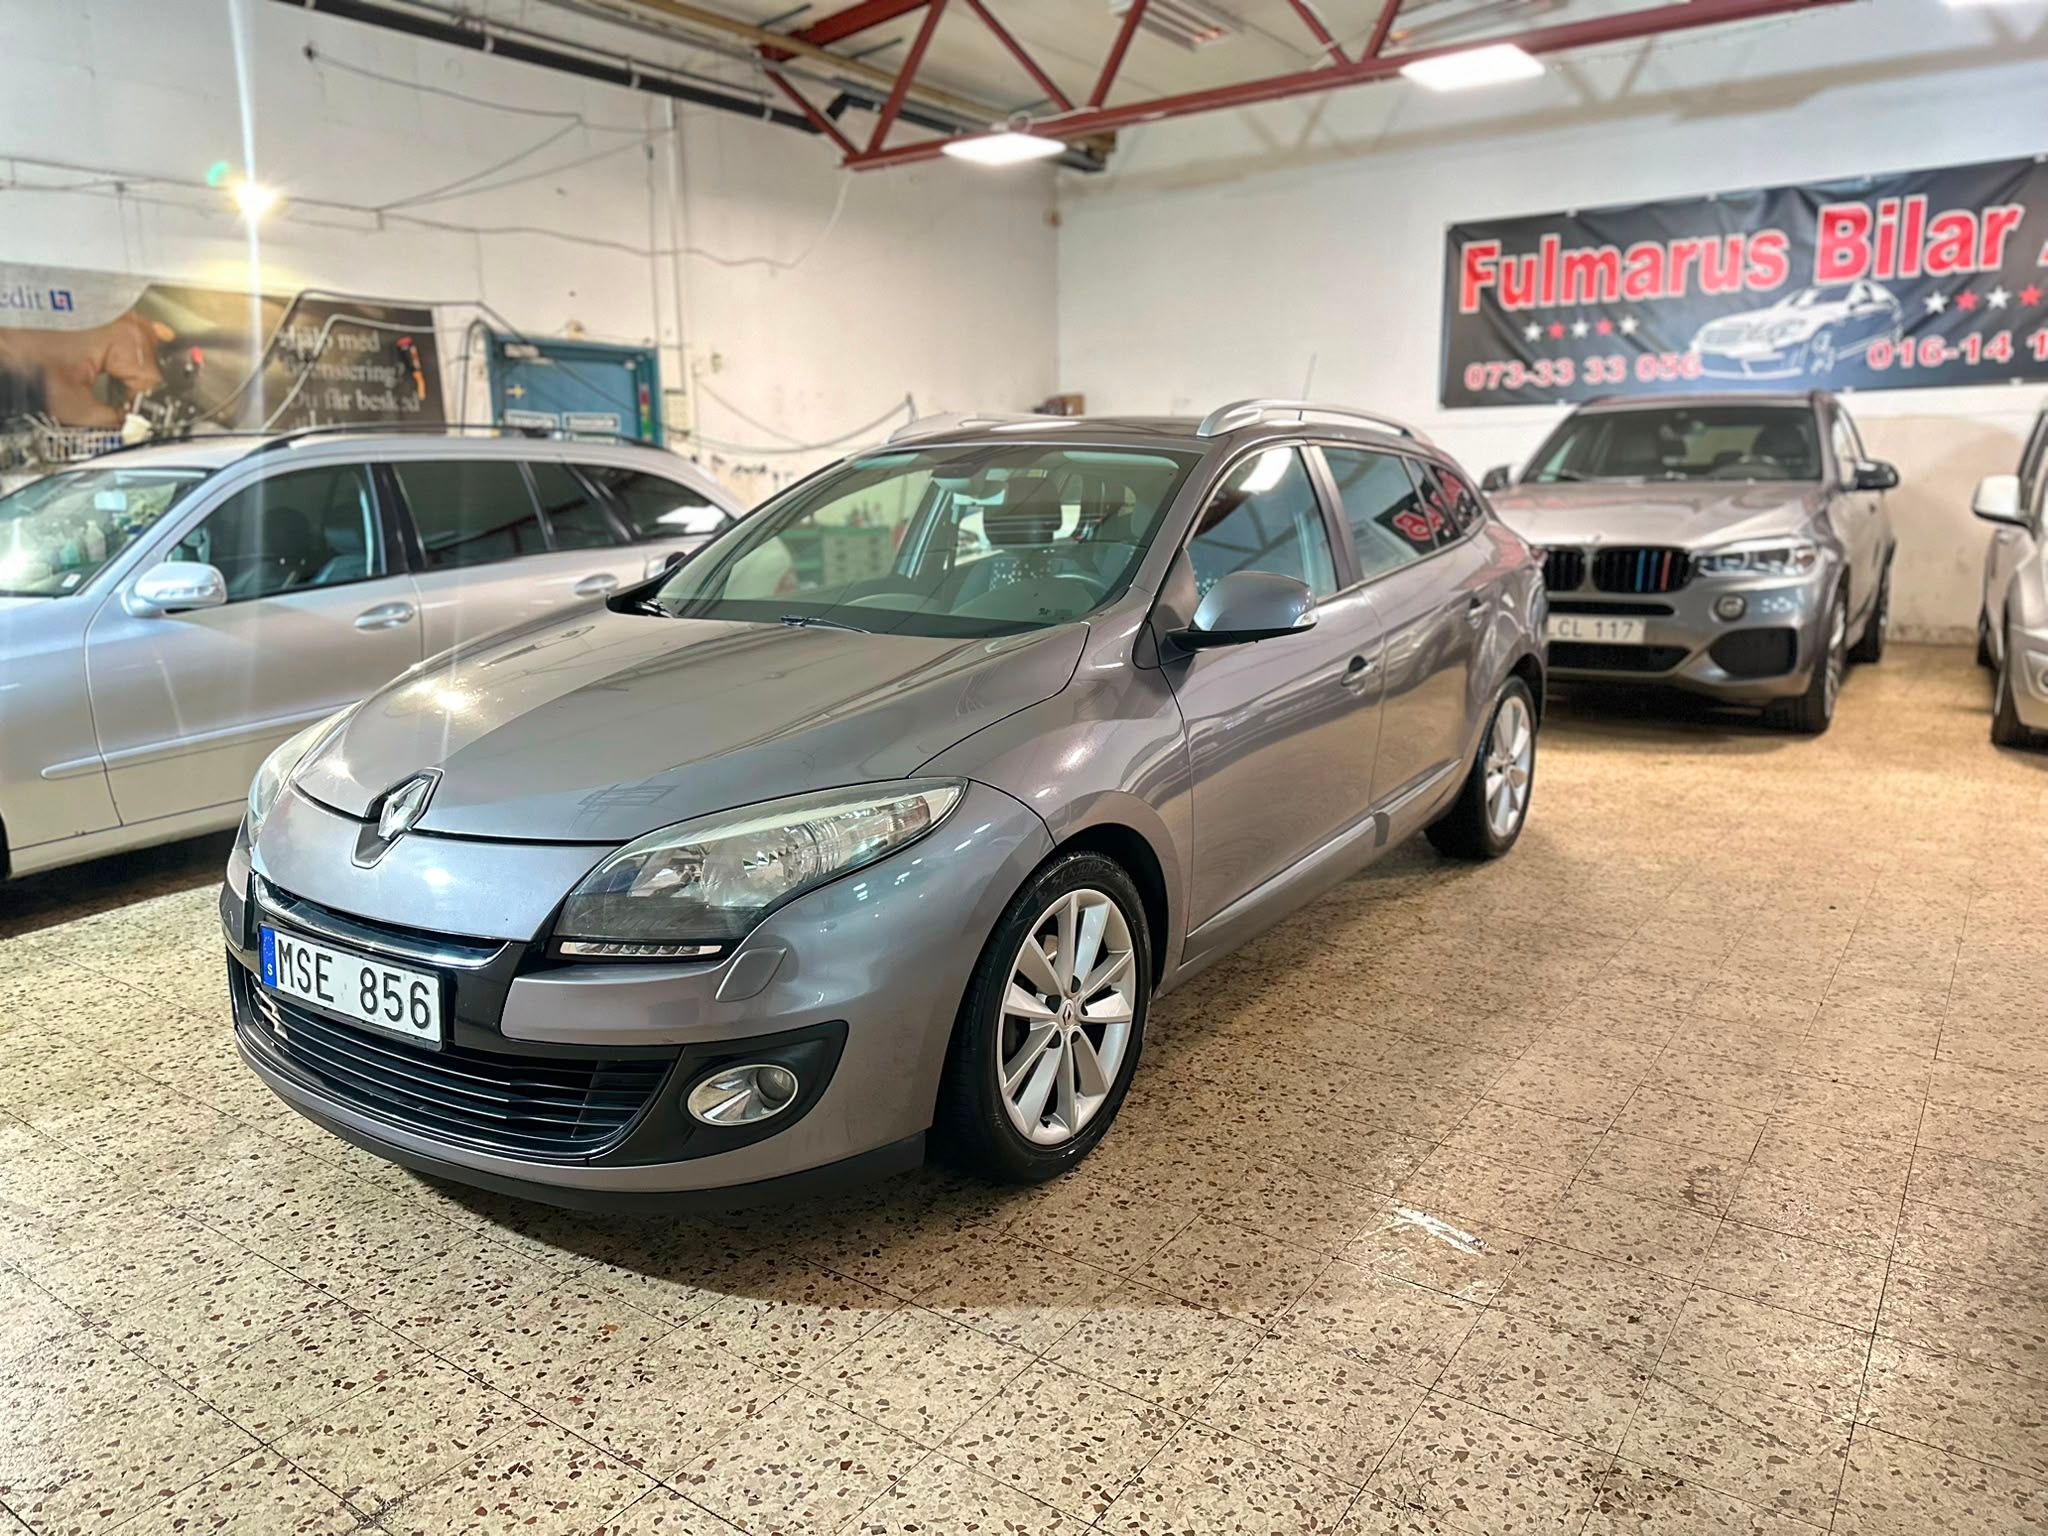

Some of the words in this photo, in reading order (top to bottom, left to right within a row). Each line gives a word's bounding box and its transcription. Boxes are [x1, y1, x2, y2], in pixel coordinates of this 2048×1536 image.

[1459, 229, 1790, 314] Fulmarus
[1814, 195, 2024, 285] Bilar
[1866, 330, 2015, 371] 016-14
[1463, 357, 1575, 391] 073-33
[1582, 354, 1627, 386] 33
[1595, 620, 1633, 638] 117
[267, 963, 273, 976] S
[277, 938, 335, 1003] MSE
[359, 966, 431, 1030] 856
